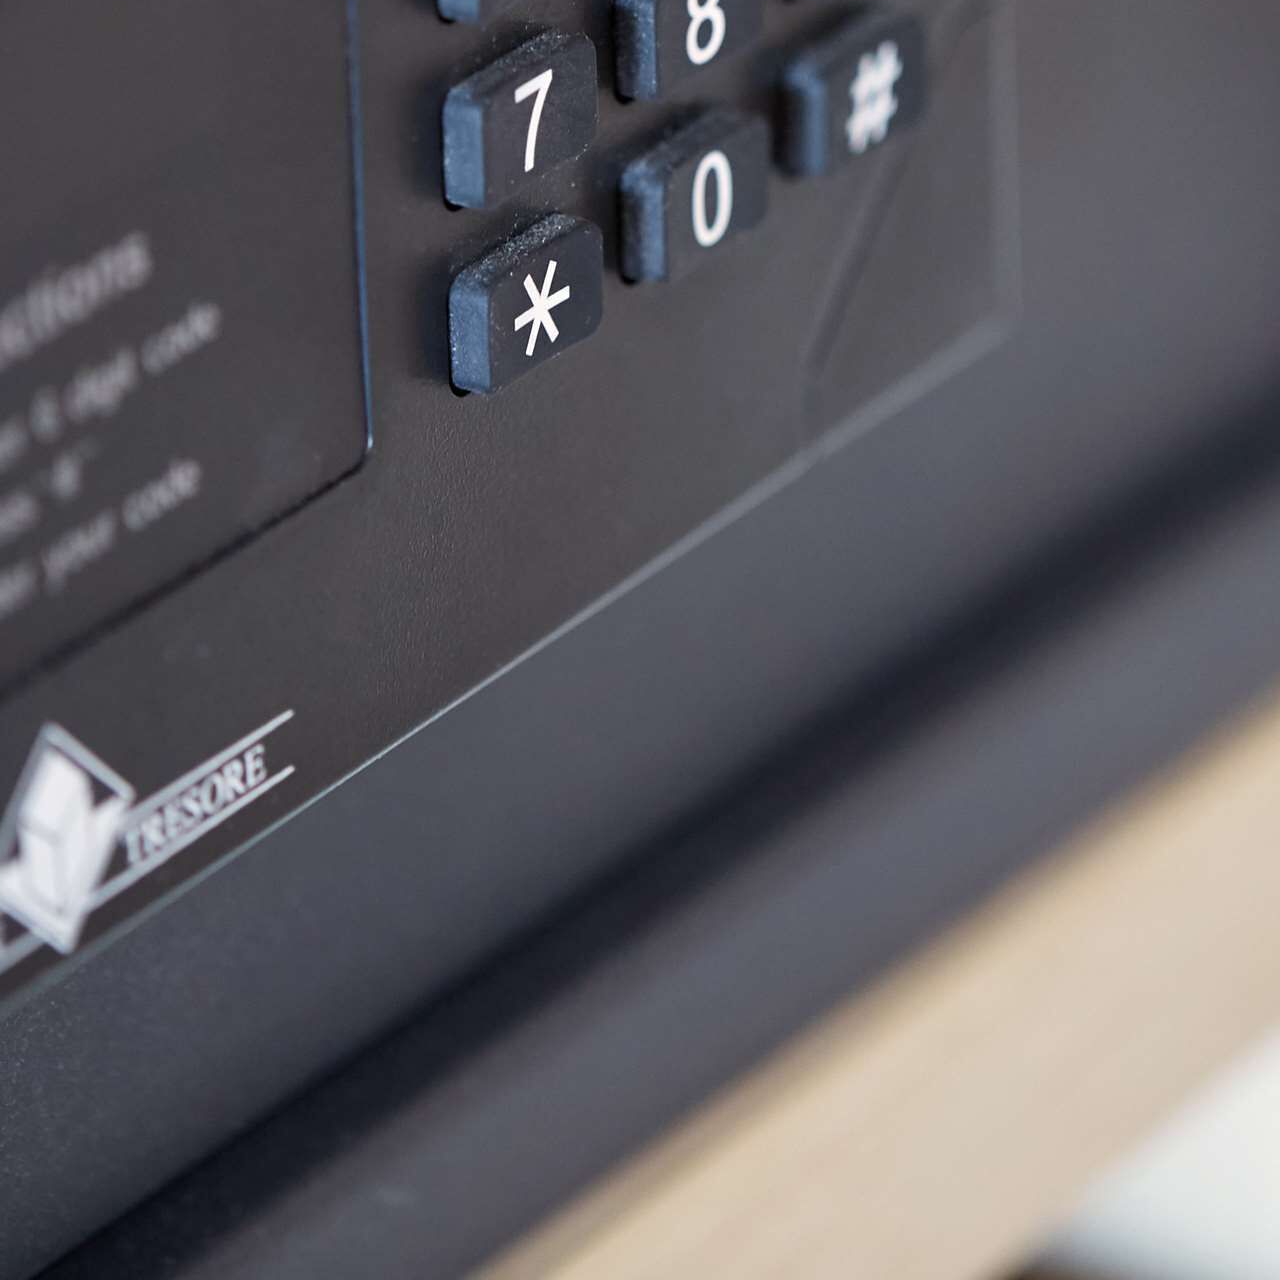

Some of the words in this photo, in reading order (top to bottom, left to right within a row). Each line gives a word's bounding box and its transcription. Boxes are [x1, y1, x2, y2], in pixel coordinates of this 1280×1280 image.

[514, 68, 554, 173] 7
[846, 40, 901, 154] #
[691, 150, 734, 248] 0
[122, 744, 267, 867] TRESORE
